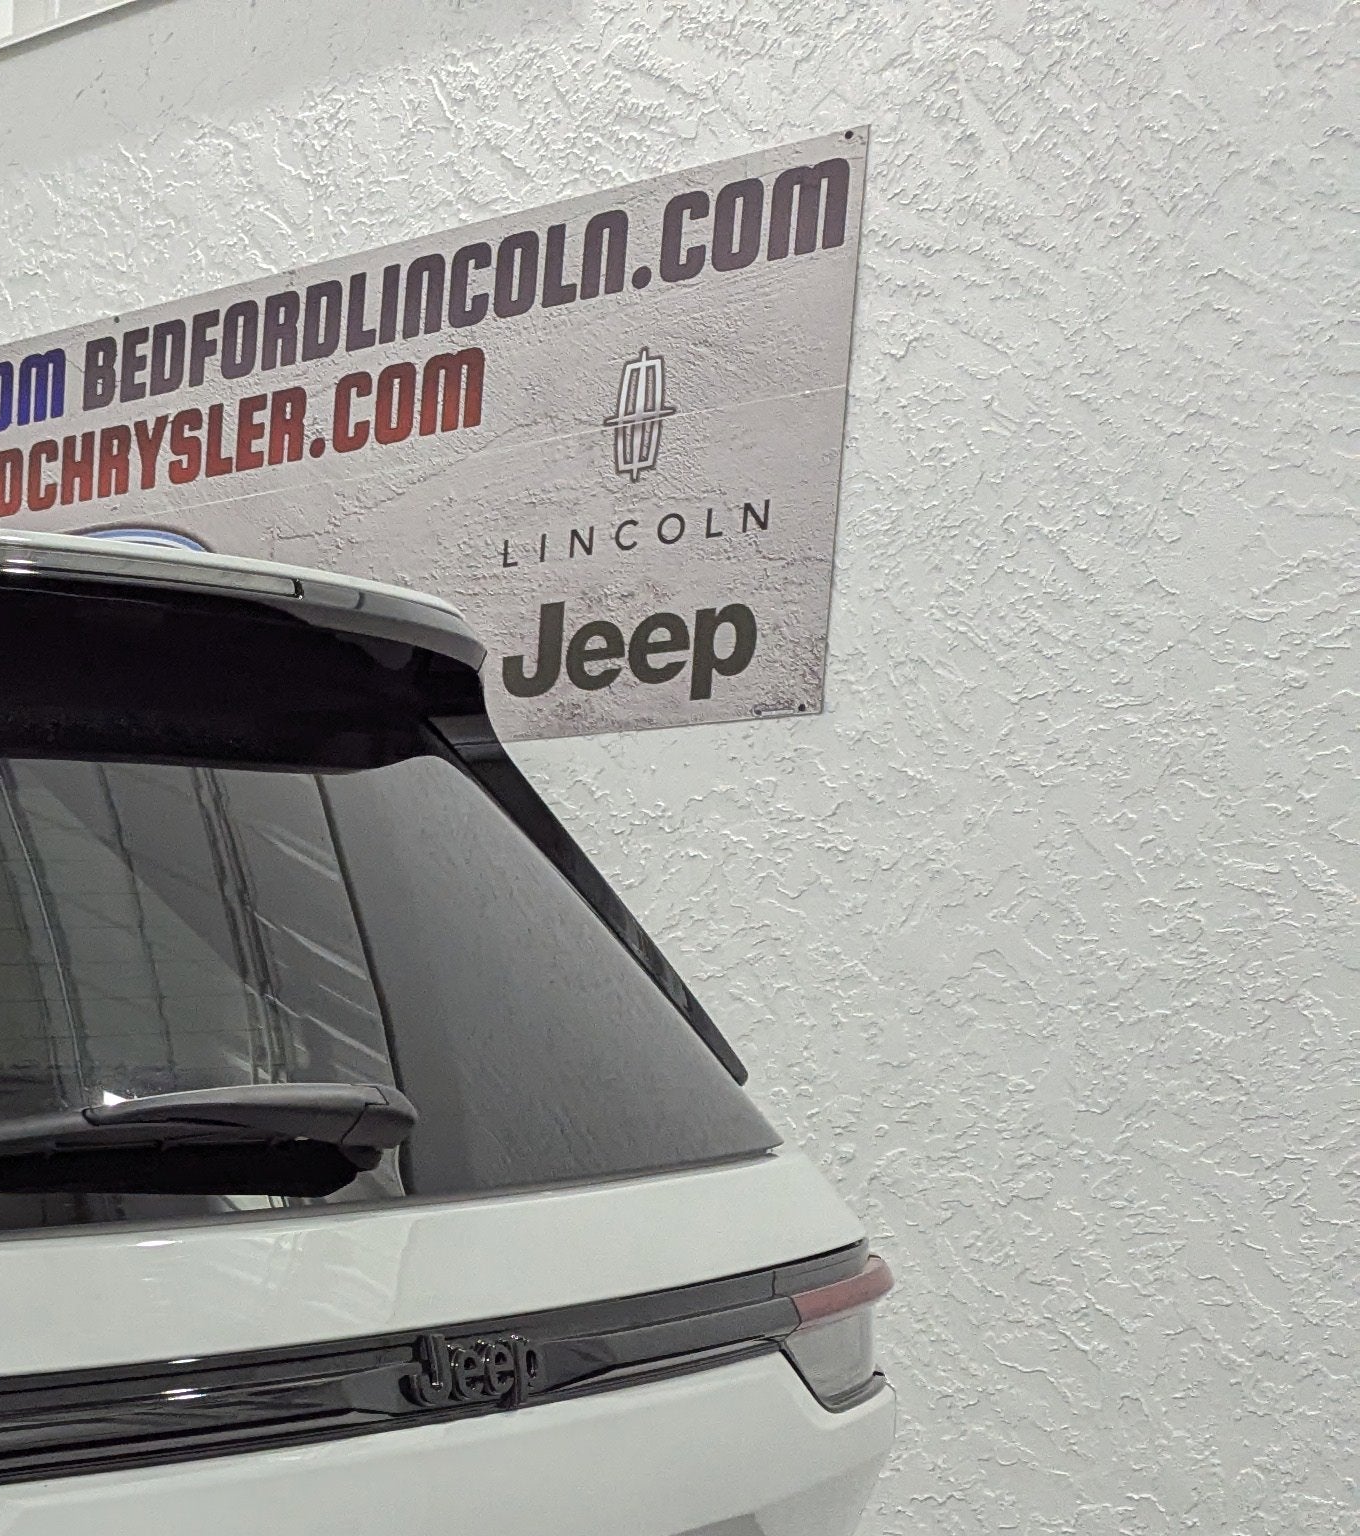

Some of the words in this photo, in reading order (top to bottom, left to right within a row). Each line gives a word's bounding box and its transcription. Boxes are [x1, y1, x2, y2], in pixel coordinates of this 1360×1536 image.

[82, 157, 851, 412] BEDFORDLINCOLN.COM
[502, 499, 771, 568] LINCOLN
[502, 601, 758, 701] Jeep
[399, 1333, 546, 1408] Jeep
